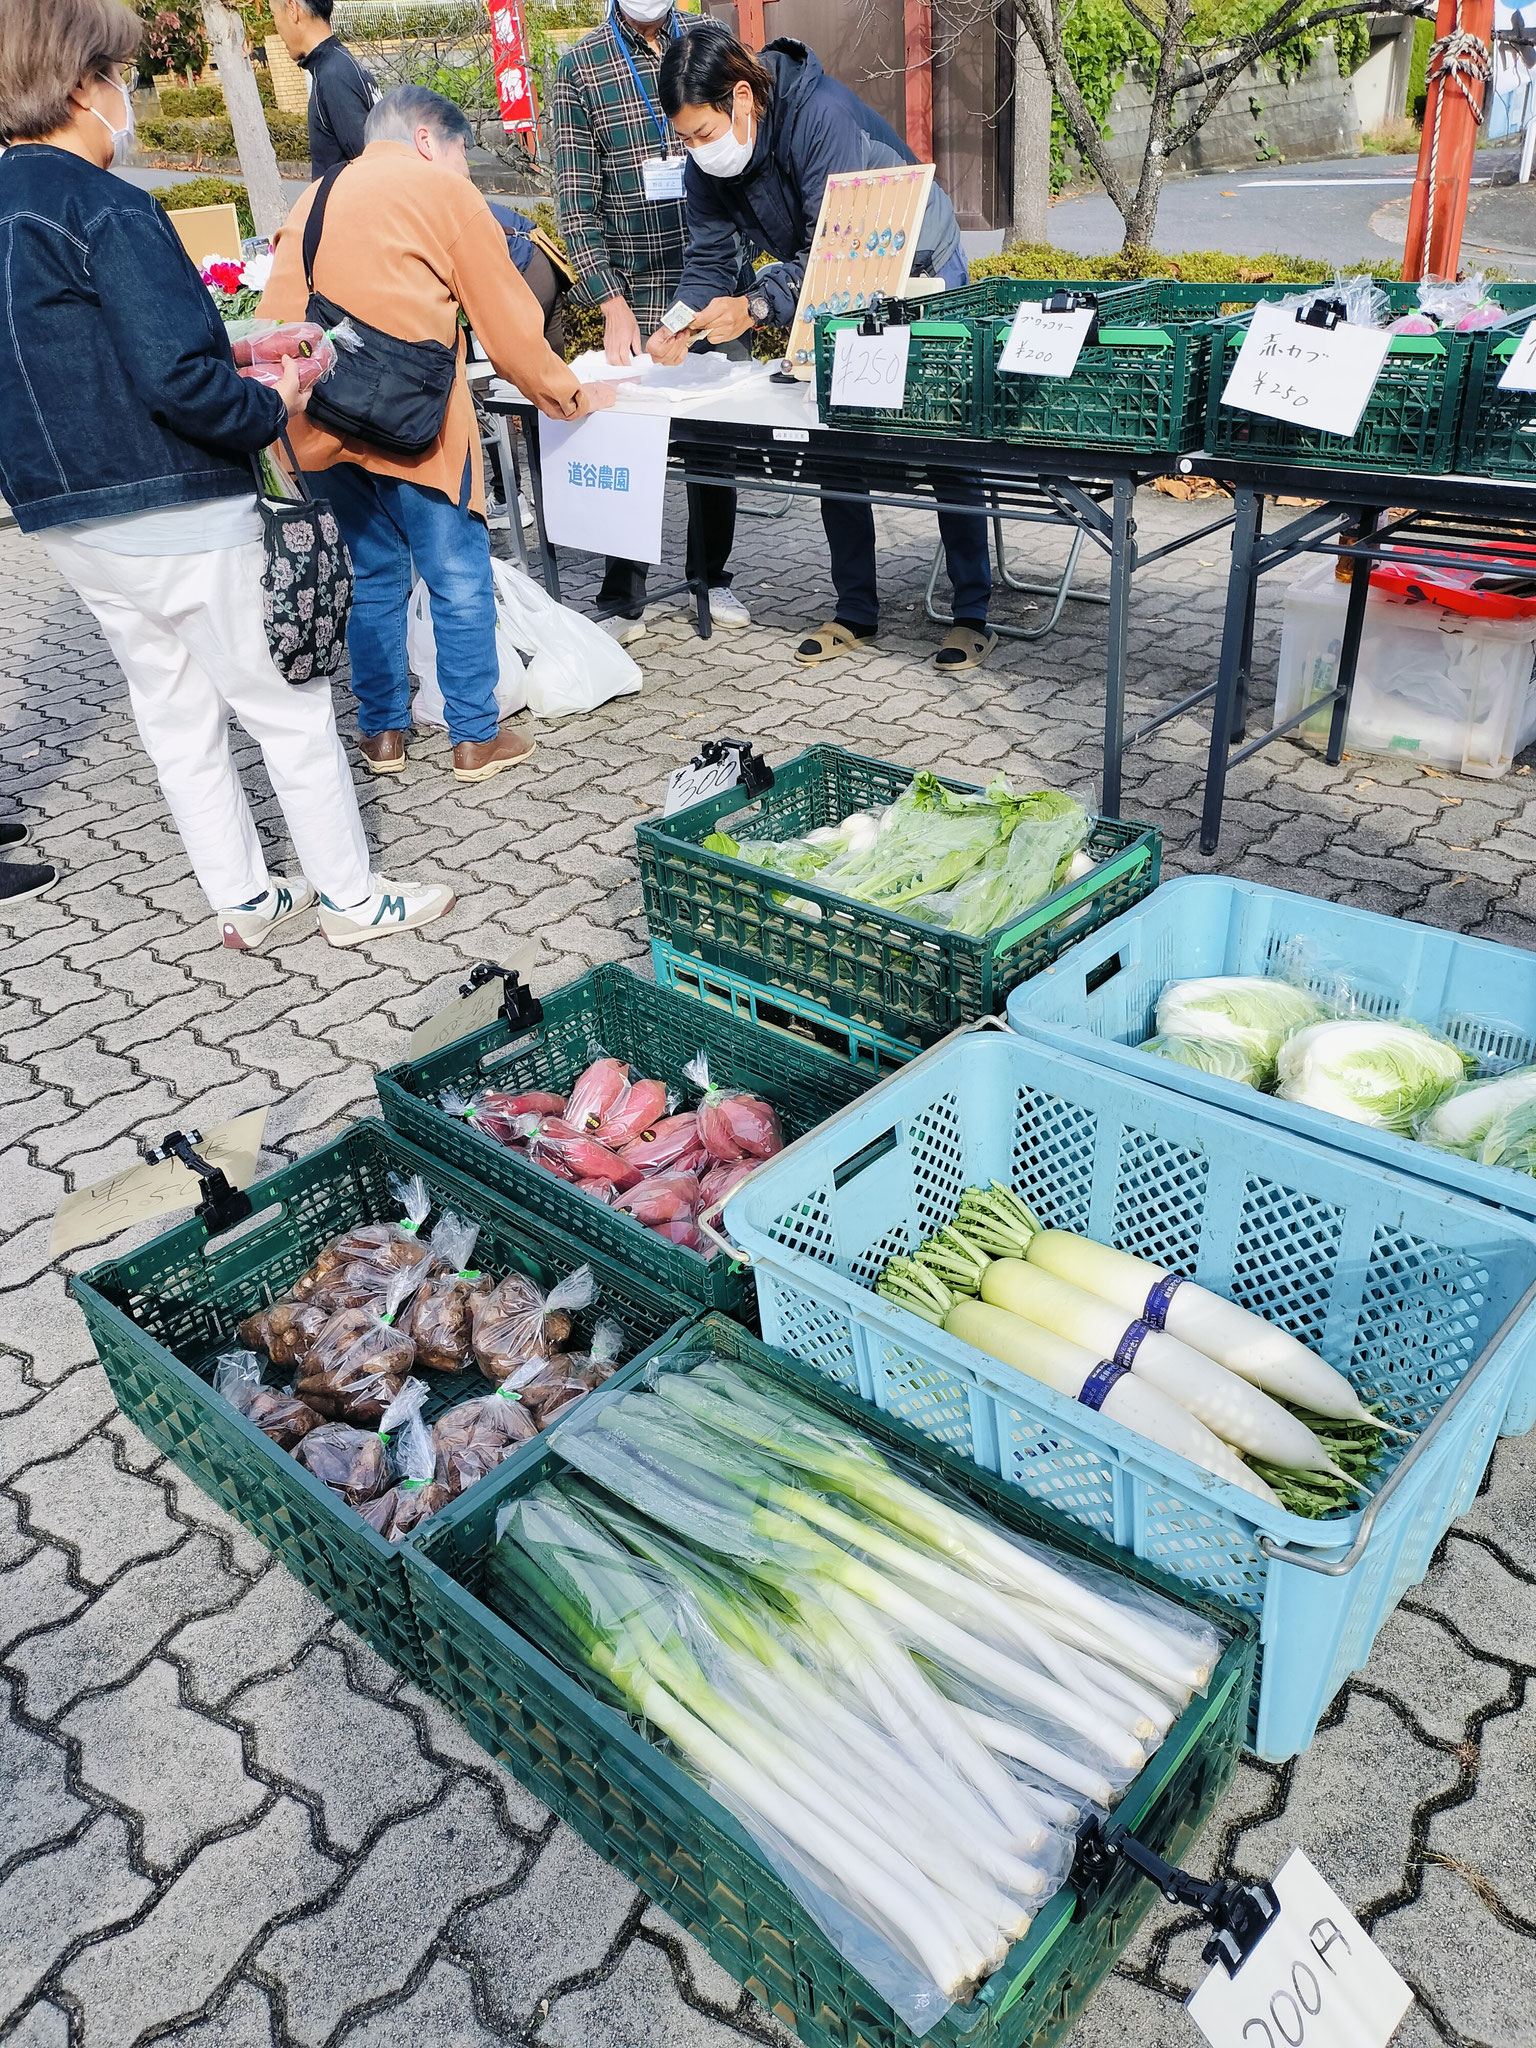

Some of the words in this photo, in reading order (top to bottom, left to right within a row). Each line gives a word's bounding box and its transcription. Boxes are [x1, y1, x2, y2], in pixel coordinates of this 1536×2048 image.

[1015, 340, 1053, 362] ¥200
[1259, 332, 1330, 363] 赤カブ
[837, 343, 900, 395] ¥250
[1253, 371, 1309, 406] ¥250
[567, 461, 630, 492] 道谷農園
